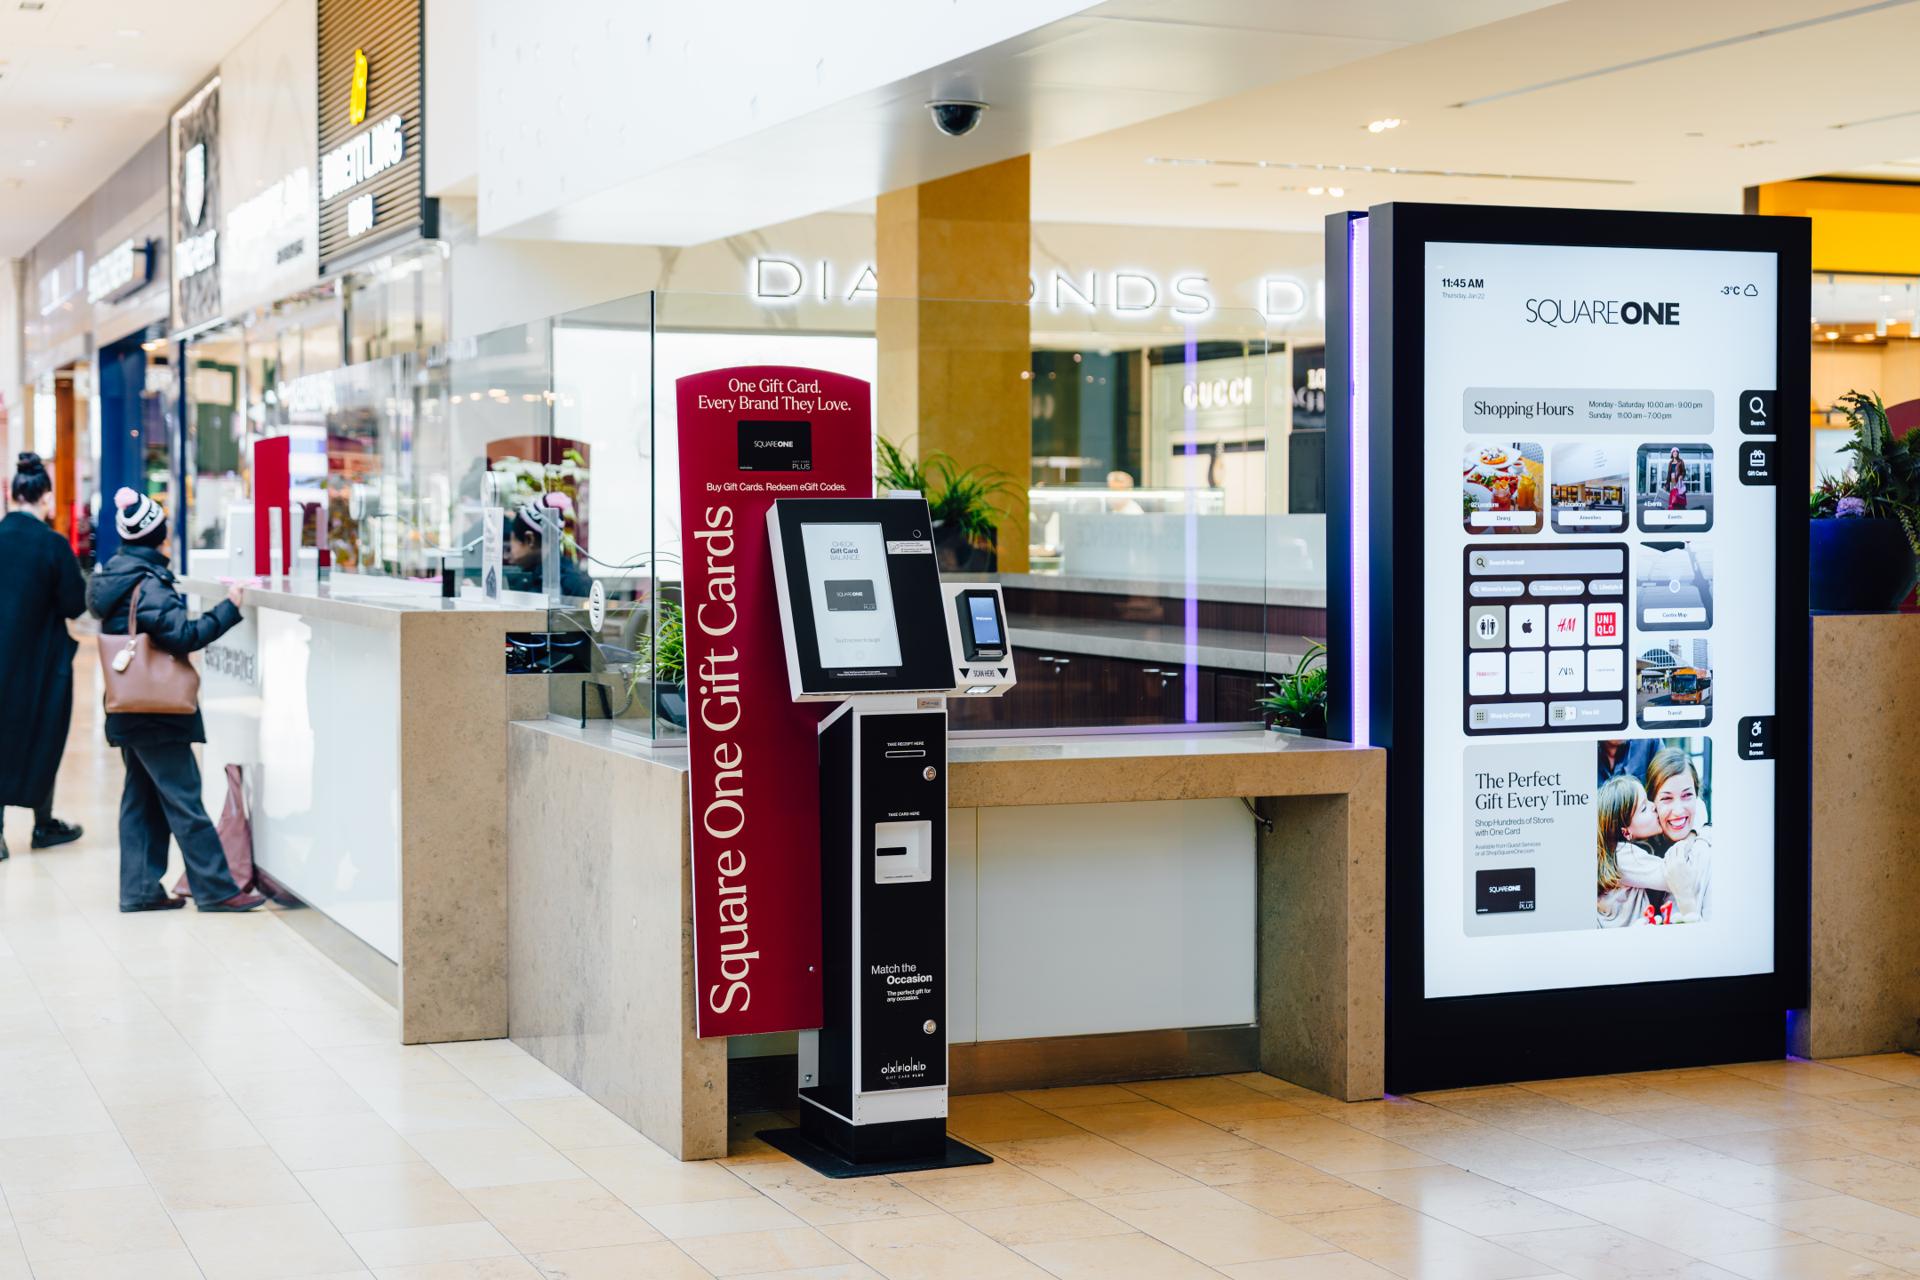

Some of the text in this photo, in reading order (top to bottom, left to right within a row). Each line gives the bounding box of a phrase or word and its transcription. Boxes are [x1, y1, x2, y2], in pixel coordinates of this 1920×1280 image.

[754, 257, 1211, 314] DIANDS
[1441, 278, 1484, 288] 11:45 AM
[728, 378, 822, 394] One Gift Card.
[1183, 376, 1253, 411] GUCCI
[698, 395, 852, 414] Every Brand They Love.
[1473, 401, 1575, 419] Shopping Hours
[1588, 401, 1614, 409] Monday
[1617, 401, 1645, 409] Saturday
[1588, 411, 1613, 420] Sunday
[706, 482, 847, 493] Buy Gift Cards. Redeem eGift Codes.
[1596, 614, 1613, 625] UNI
[1596, 625, 1615, 636] QLO
[986, 669, 995, 677] HERE
[693, 505, 760, 1014] Square One Gift Cards
[1475, 770, 1561, 789] The Perfect
[1475, 789, 1589, 811] Gift Every Time
[1475, 816, 1554, 828] Shop Hundreds of Stores
[1504, 827, 1521, 835] Card
[871, 963, 917, 975] Match the
[886, 973, 933, 985] Occasion
[897, 989, 915, 997] perfect
